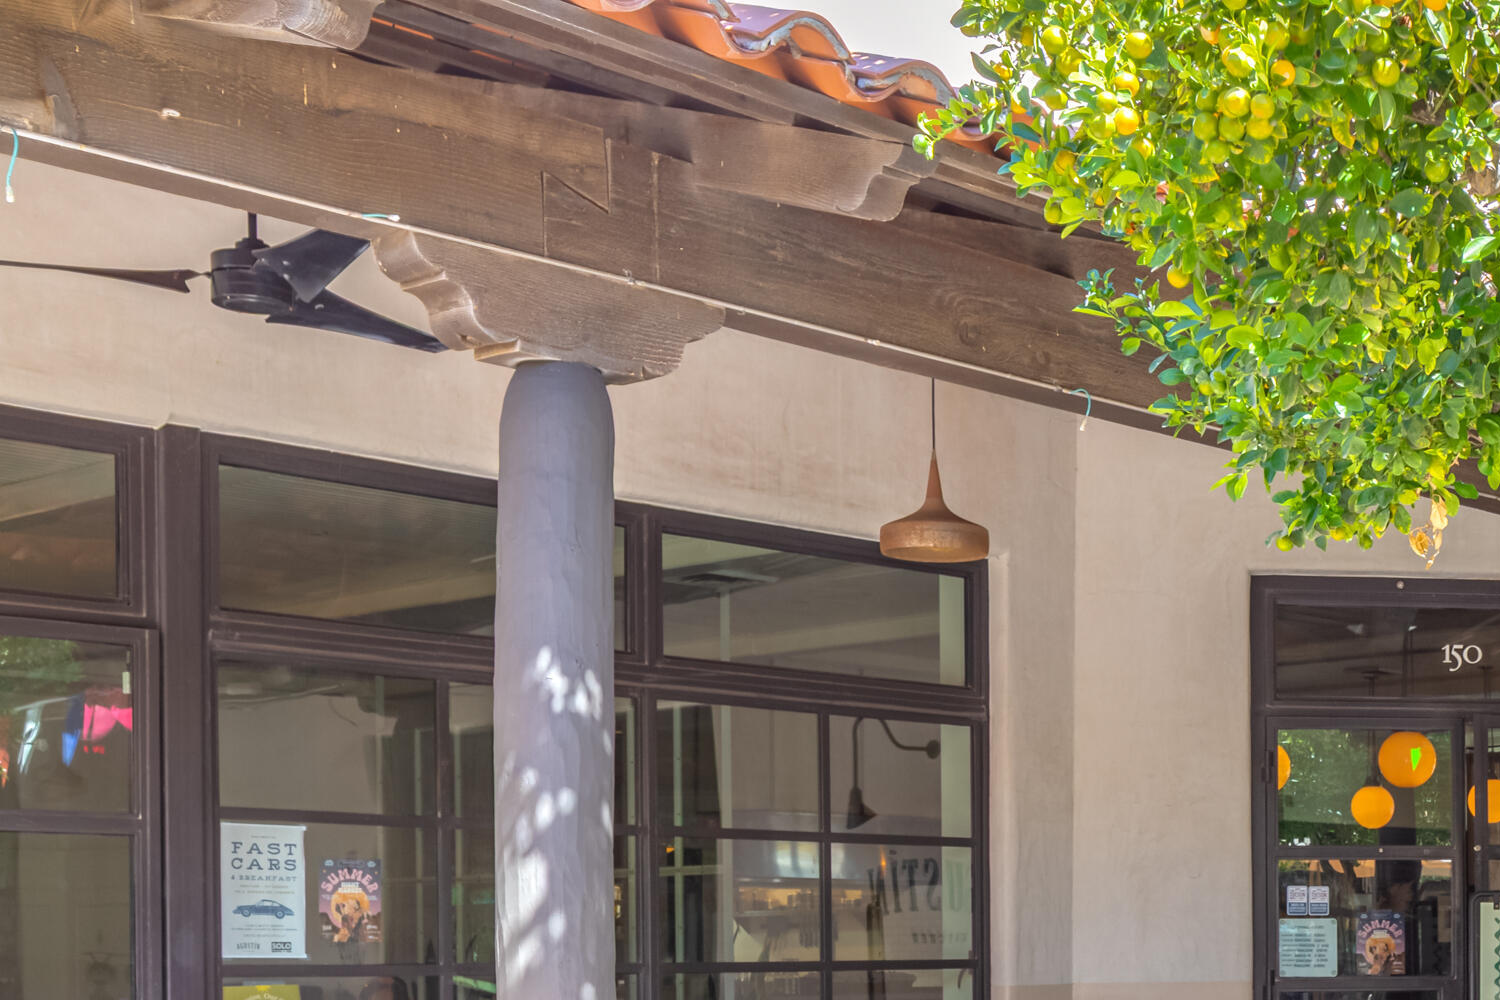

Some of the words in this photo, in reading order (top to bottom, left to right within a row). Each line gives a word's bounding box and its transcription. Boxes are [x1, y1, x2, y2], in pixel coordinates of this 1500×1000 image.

[1441, 644, 1483, 672] 150
[231, 841, 297, 856] FAST
[231, 857, 297, 871] CARS
[321, 868, 379, 893] SUMMER
[1357, 919, 1404, 938] SUMMER
